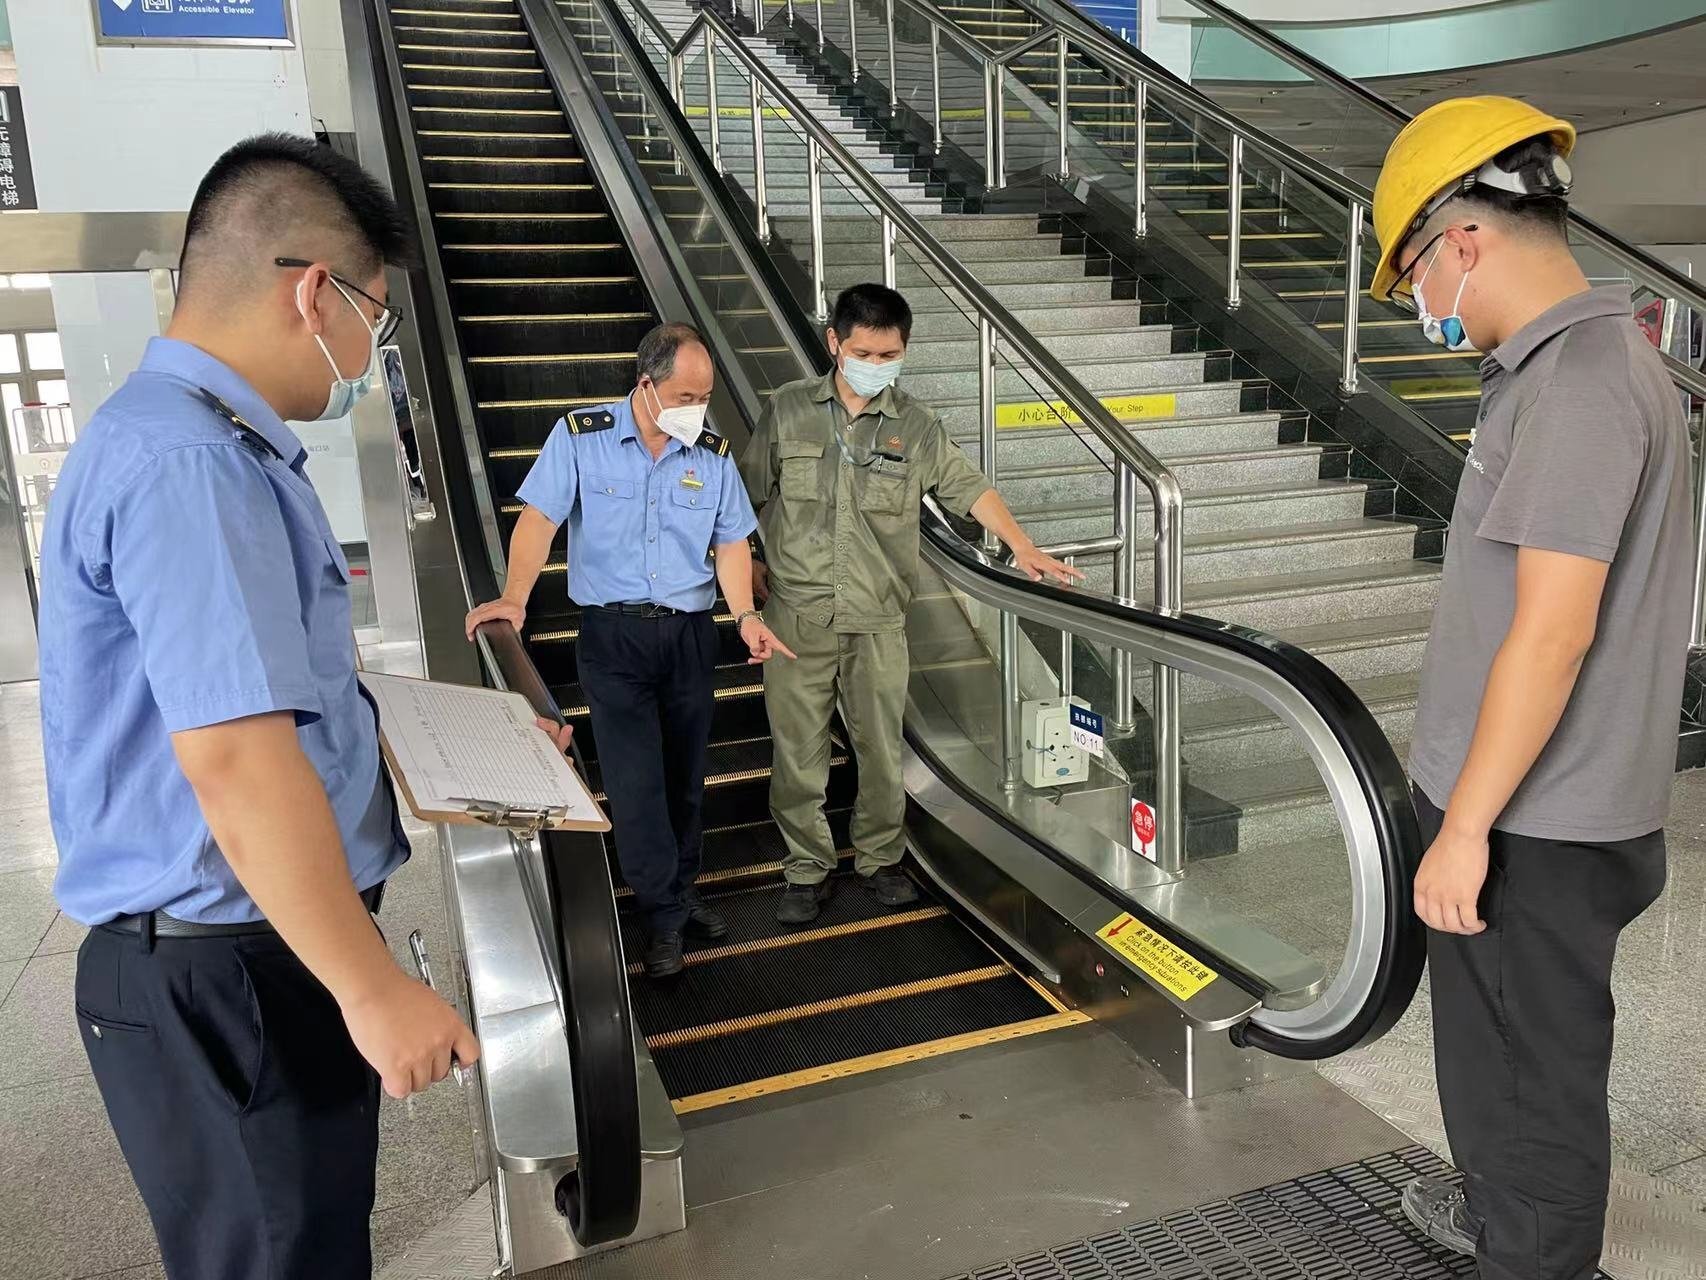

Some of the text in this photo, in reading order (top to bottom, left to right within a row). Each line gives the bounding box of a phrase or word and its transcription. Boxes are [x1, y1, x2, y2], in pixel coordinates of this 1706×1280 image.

[179, 4, 255, 14] Accessible Elevator
[1018, 406, 1072, 422] 小心台阶
[1127, 404, 1144, 413] Step
[1135, 811, 1153, 831] 急停
[1126, 935, 1179, 975] Click on the button
[1135, 928, 1209, 981] 紧急情况下请按此键
[1125, 944, 1157, 971] emergency
[1155, 968, 1188, 993] situations
